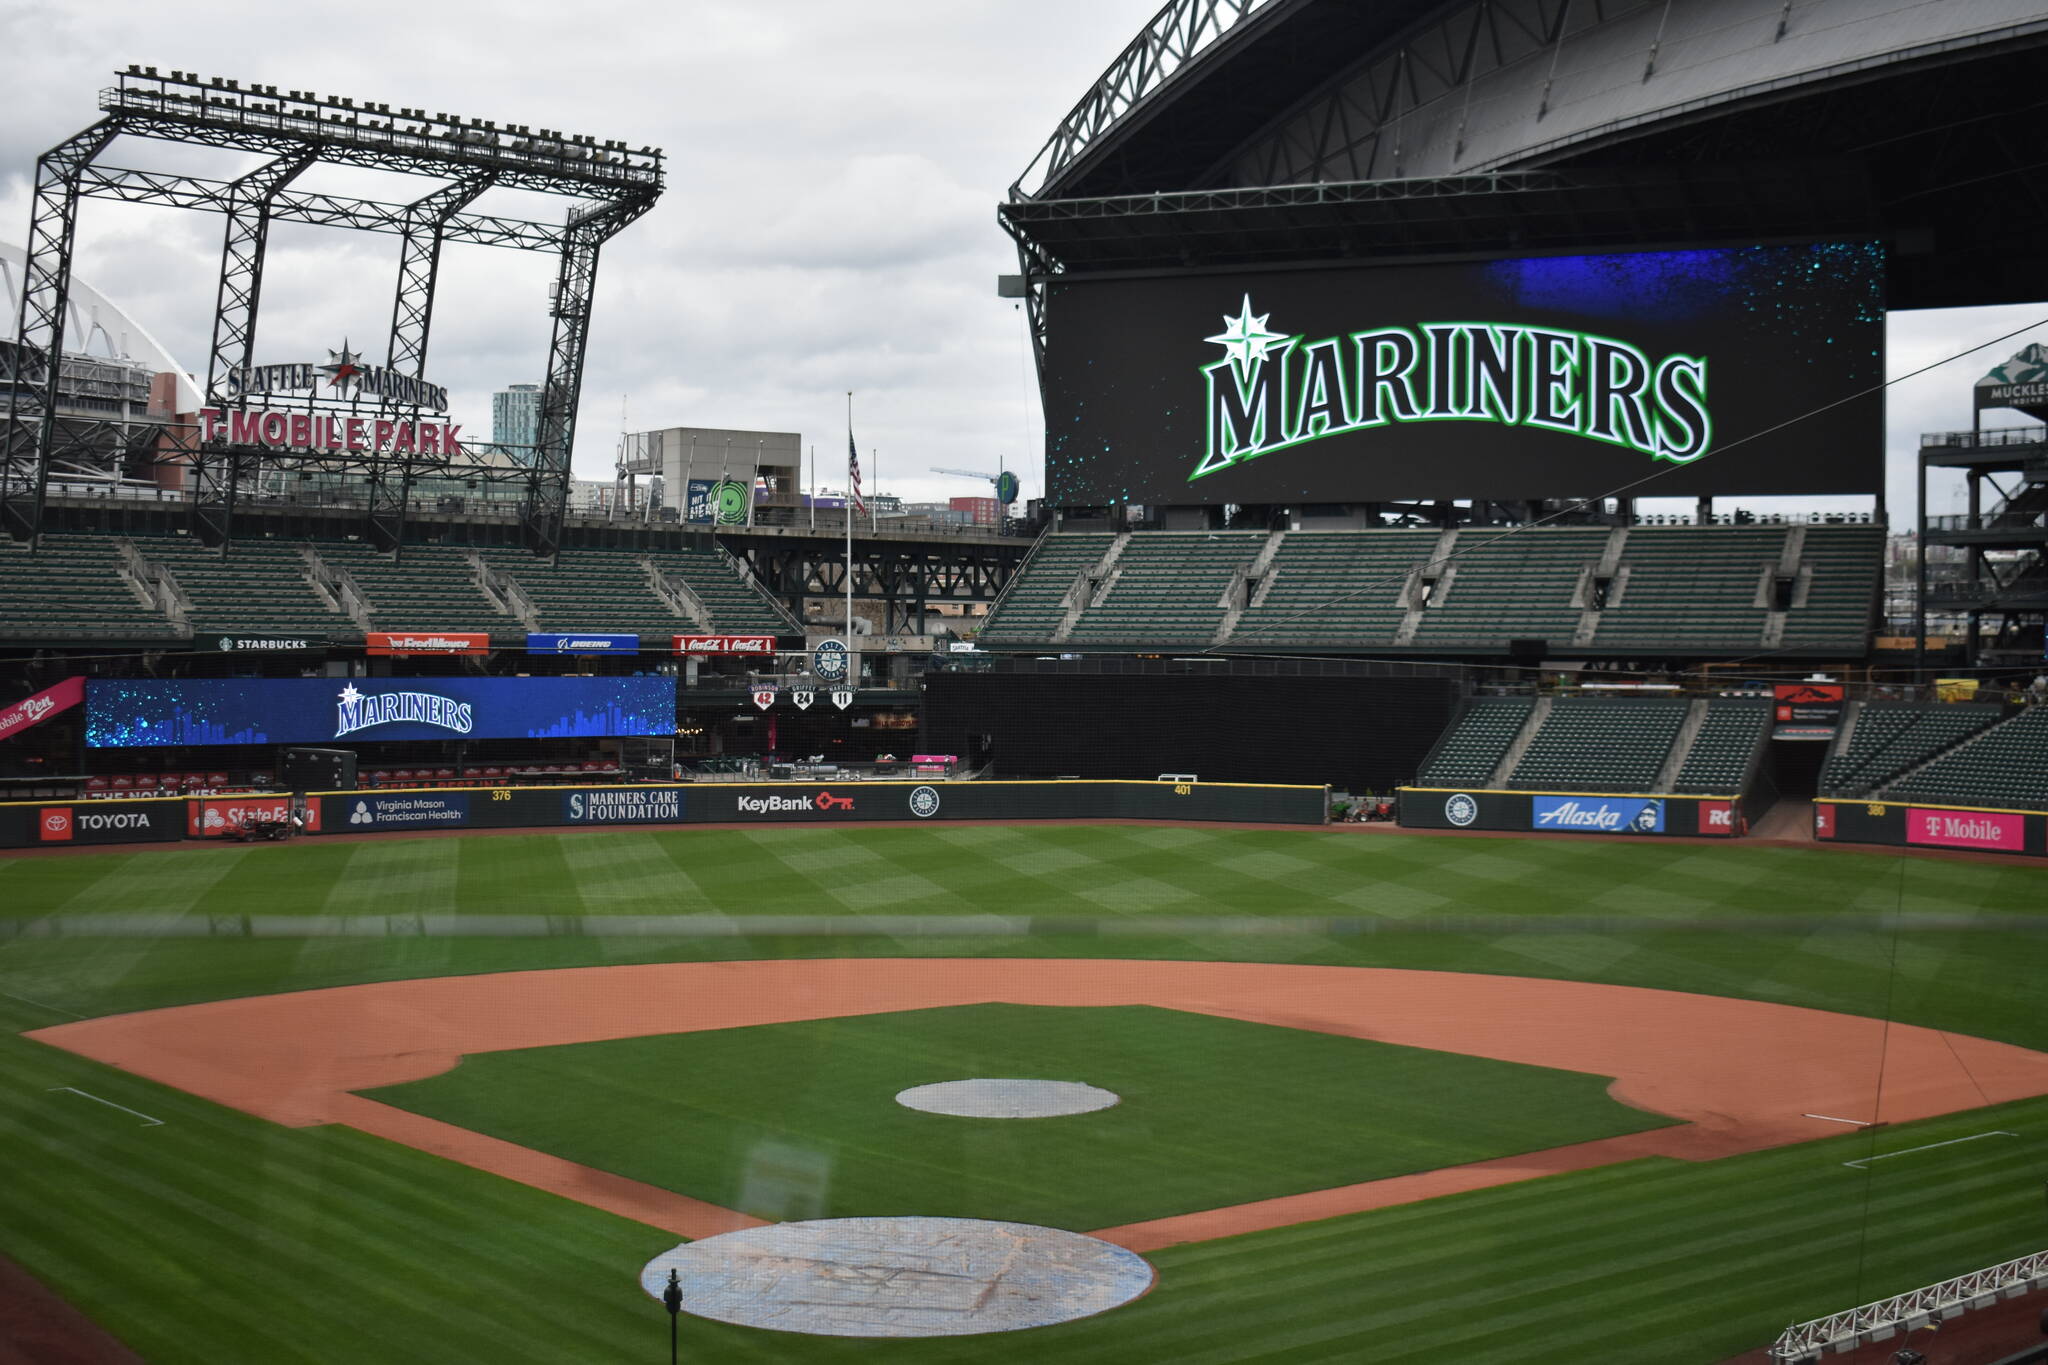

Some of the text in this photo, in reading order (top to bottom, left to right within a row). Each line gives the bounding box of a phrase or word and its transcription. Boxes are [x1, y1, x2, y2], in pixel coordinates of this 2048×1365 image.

[227, 363, 449, 413] SEATTLE MARINERS
[1991, 383, 2048, 399] MUCKLE
[1187, 322, 1713, 481] MARINERS
[200, 406, 463, 457] T-MOBILE PARK
[237, 639, 307, 649] STARBUCKS
[571, 640, 611, 648] BOEING
[757, 692, 772, 704] 42
[797, 692, 810, 704] 24
[838, 692, 848, 704] 11
[334, 692, 473, 738] MARINERS
[492, 791, 511, 801] 376
[1174, 784, 1191, 795] 401
[589, 791, 679, 805] MARINERS CARE
[738, 796, 813, 813] KeyBank
[376, 799, 445, 812] Virginia Mason
[589, 804, 679, 819] FOUNDATION
[1867, 804, 1886, 816] 380
[78, 813, 150, 830] TOYOTA
[376, 810, 461, 822] Franciscan Health
[1539, 801, 1621, 828] Alaska
[1944, 817, 2001, 841] Mobile
